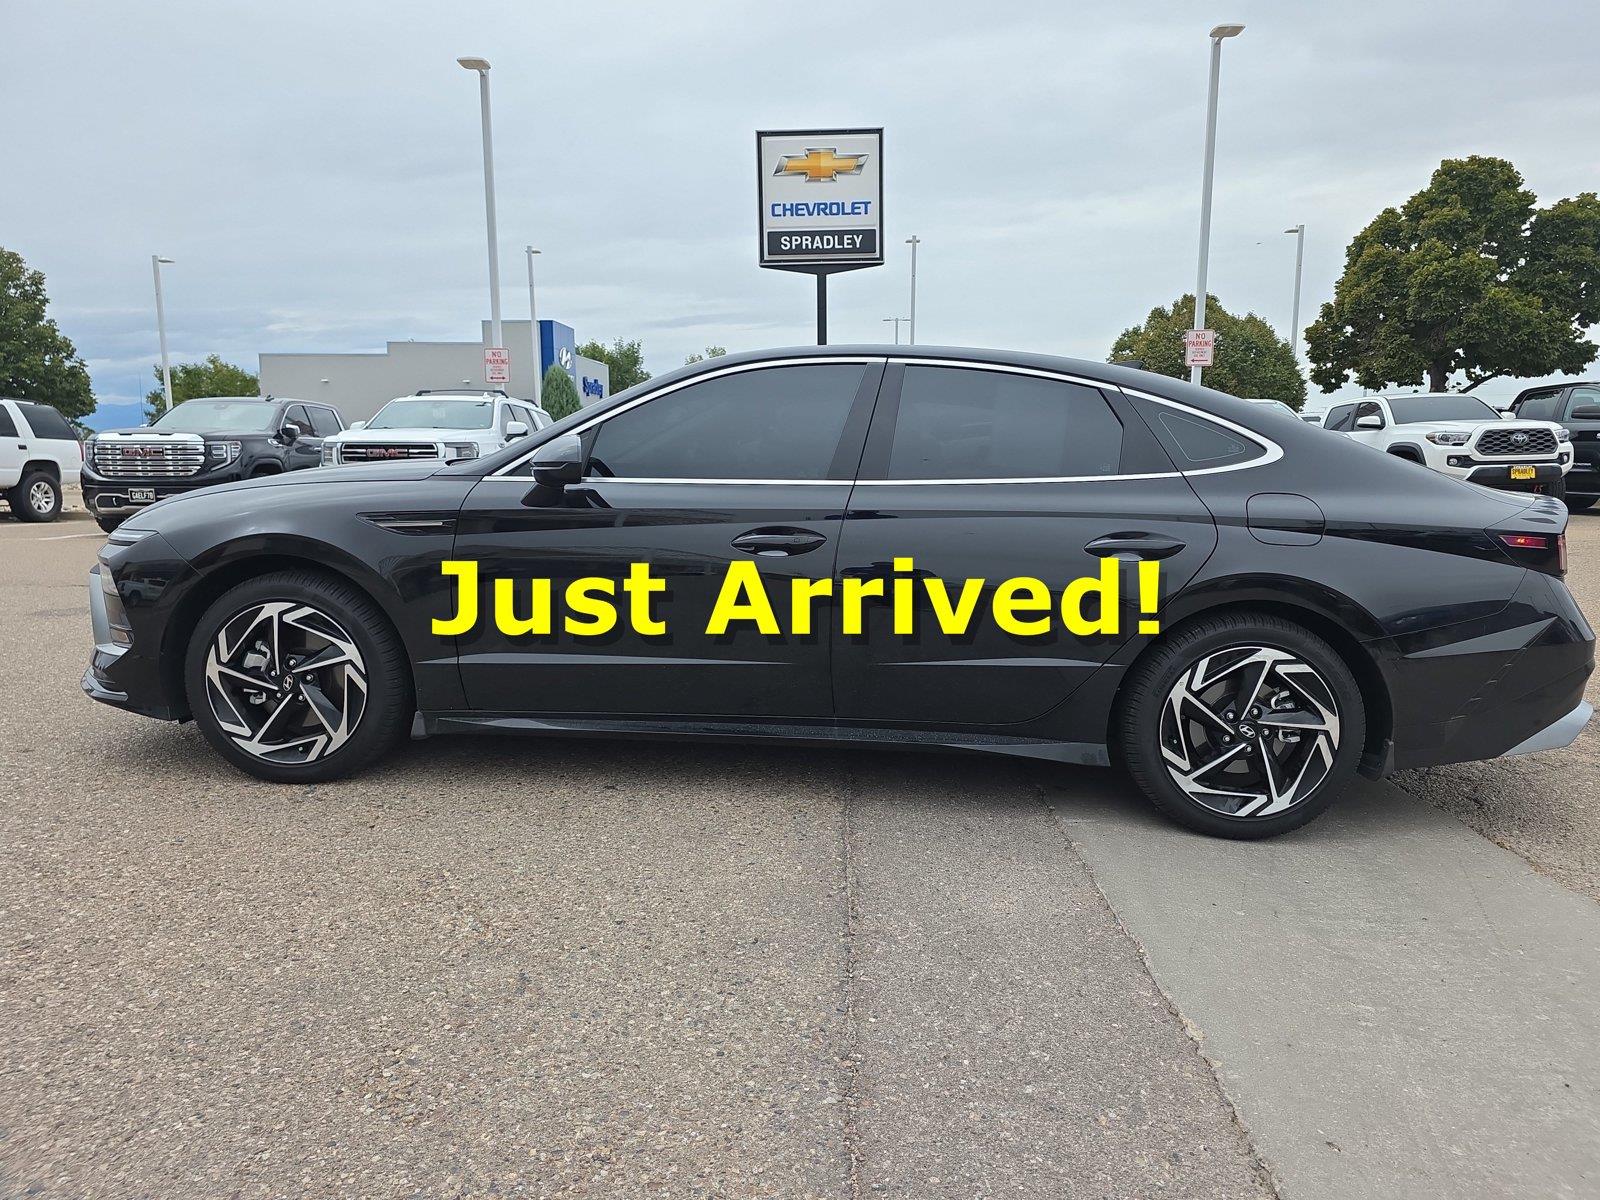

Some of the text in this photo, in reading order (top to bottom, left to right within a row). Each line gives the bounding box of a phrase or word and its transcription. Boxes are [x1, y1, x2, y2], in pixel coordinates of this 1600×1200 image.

[771, 201, 871, 217] CHEVROLET
[780, 234, 863, 250] SPRADLEY
[122, 447, 163, 457] GMC
[366, 448, 408, 457] GMC
